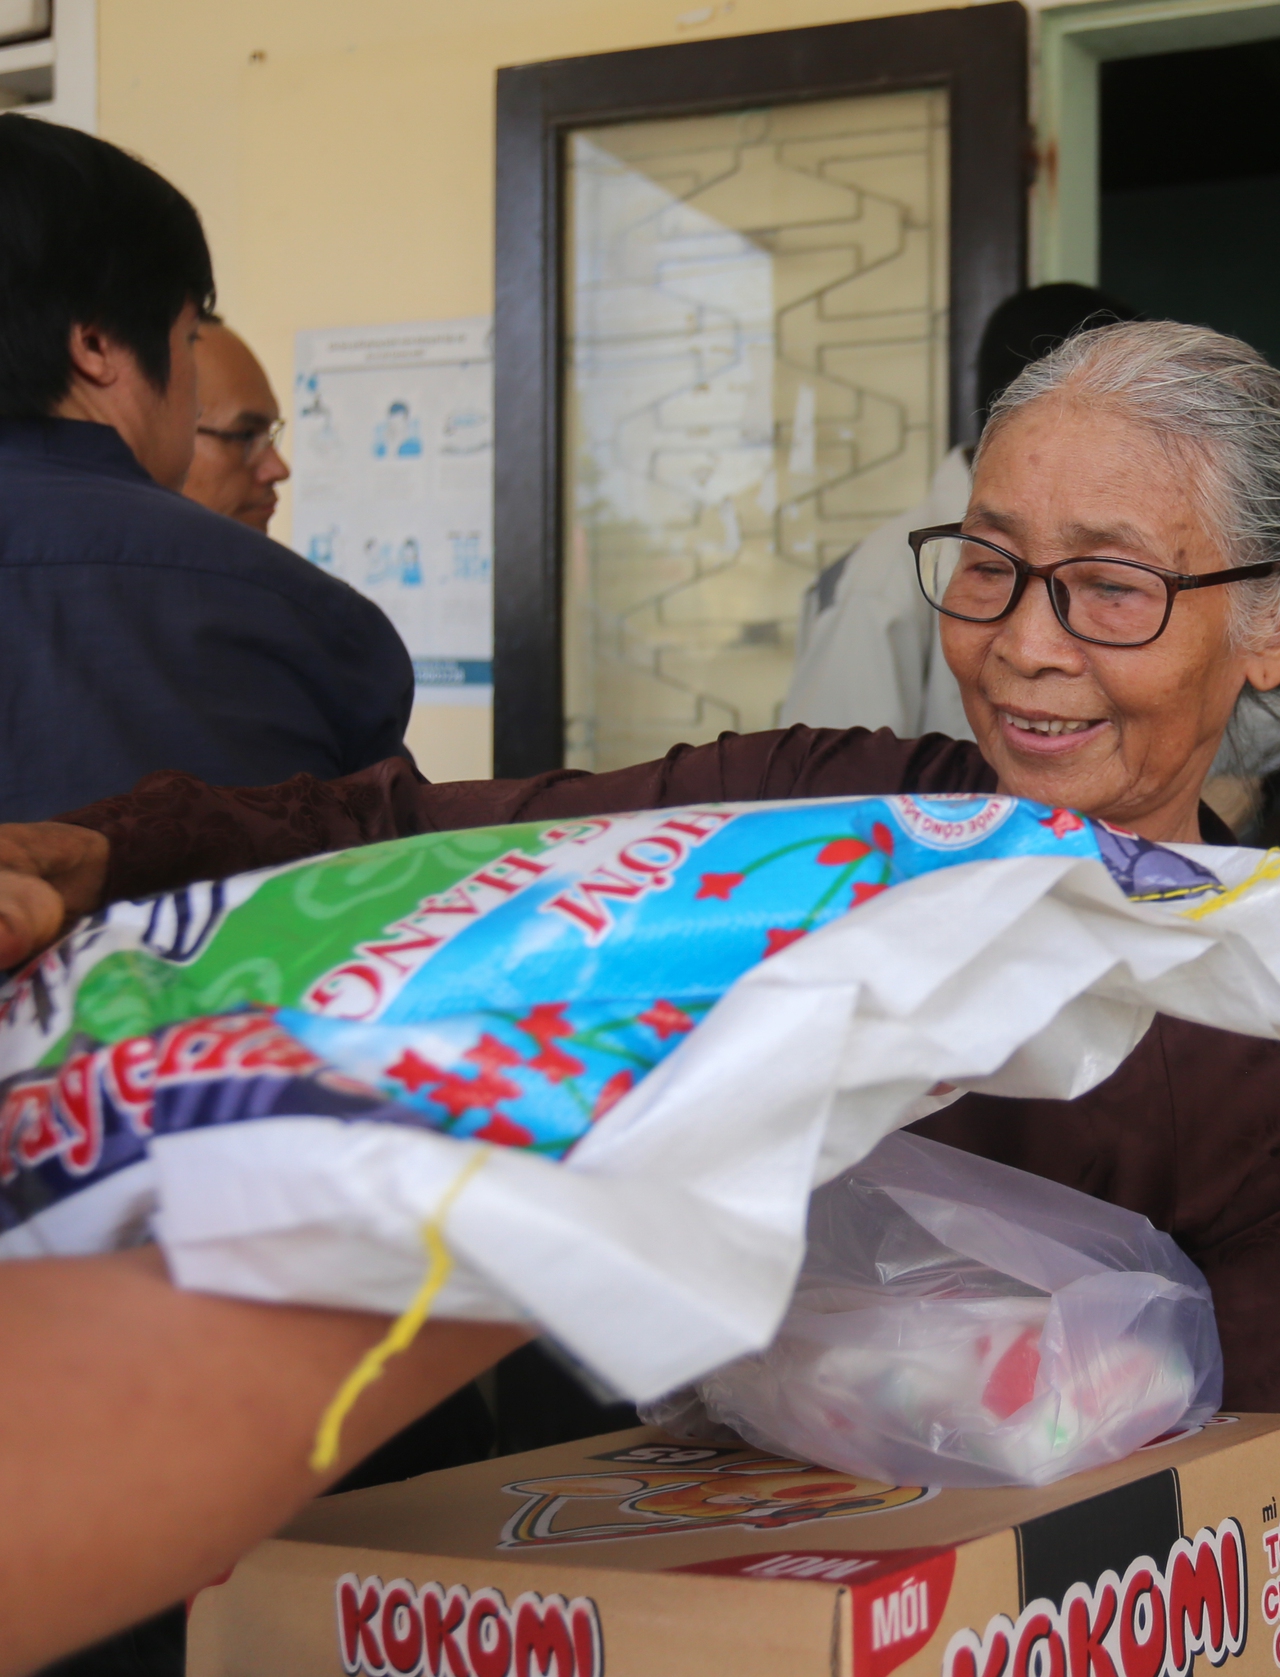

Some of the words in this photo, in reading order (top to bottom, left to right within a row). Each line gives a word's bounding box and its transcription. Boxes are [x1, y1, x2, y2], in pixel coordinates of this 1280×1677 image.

[310, 851, 554, 1021] HẠNG
[1262, 1496, 1277, 1523] mì
[338, 1576, 600, 1677] KOKOMI
[871, 1575, 929, 1651] MỚI
